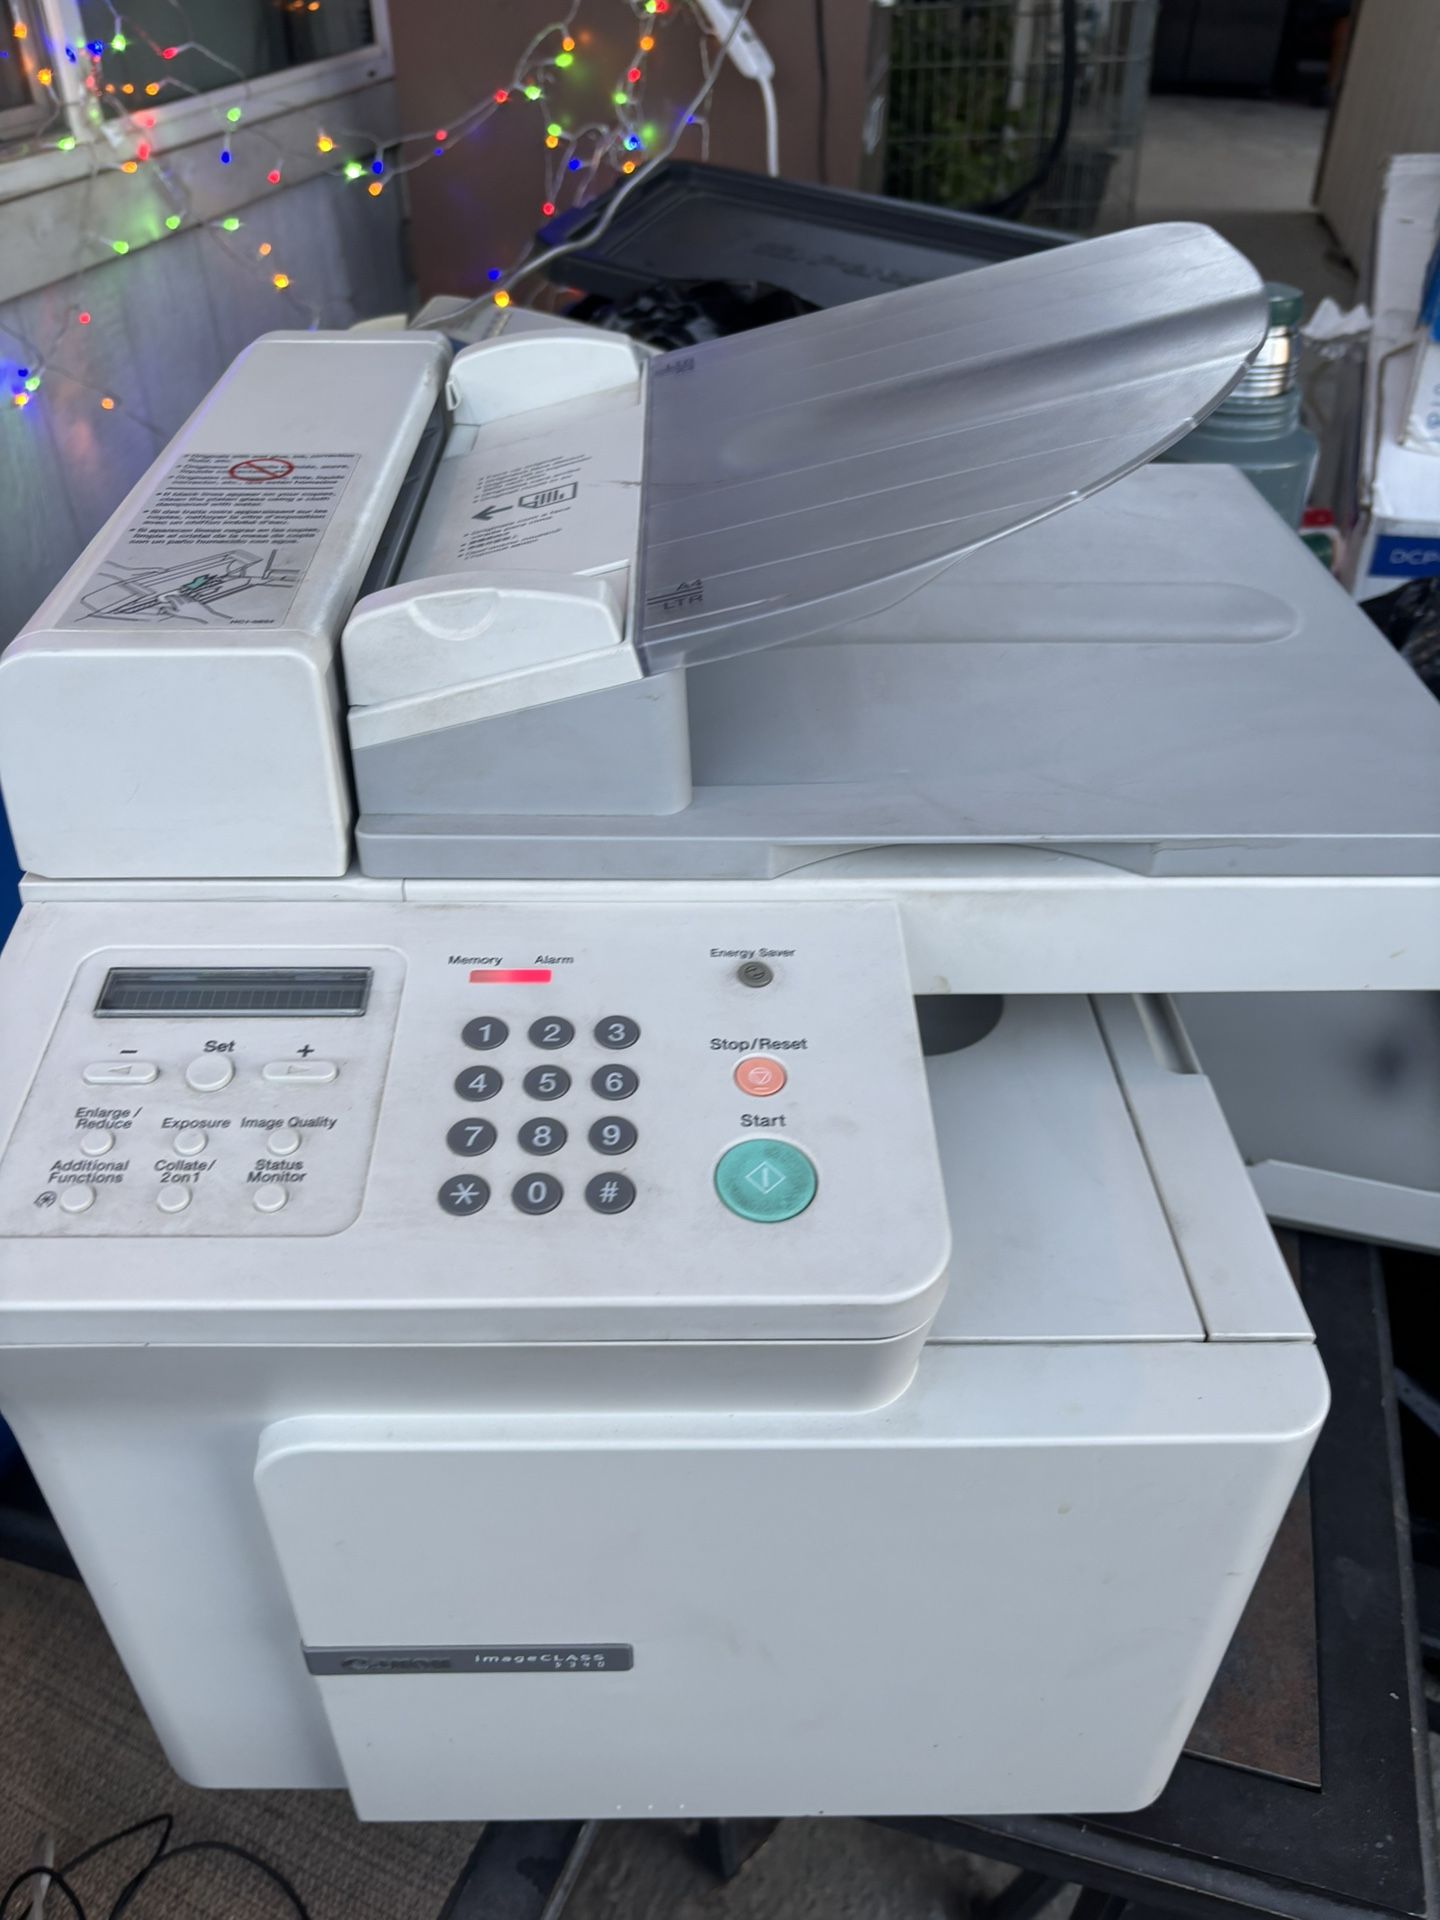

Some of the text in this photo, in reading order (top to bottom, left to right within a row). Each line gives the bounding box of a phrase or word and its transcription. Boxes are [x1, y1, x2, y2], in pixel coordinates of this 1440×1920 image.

[448, 955, 574, 967] Memory Alarm
[709, 947, 796, 960] Energy Saver
[478, 1023, 492, 1042] 1
[542, 1023, 562, 1042] 2
[607, 1023, 626, 1042] 3
[203, 1040, 235, 1053] Set
[710, 1037, 808, 1053] Stop/Reset
[468, 1073, 487, 1093] 4
[538, 1072, 557, 1093] 5
[604, 1072, 624, 1092] 6
[75, 1118, 133, 1129] Reduce
[161, 1117, 231, 1131] Exposure
[240, 1116, 338, 1131] Image Quality
[740, 1113, 786, 1128] Start
[464, 1125, 484, 1147] 7
[531, 1125, 552, 1147] 8
[602, 1124, 621, 1146] 9
[50, 1159, 130, 1172] Additional
[154, 1159, 217, 1172] Collate/
[255, 1158, 303, 1171] Status
[47, 1172, 123, 1184] Functions
[246, 1171, 307, 1183] Monitor
[527, 1181, 547, 1204] 0
[474, 1653, 606, 1664] imageCLASS
